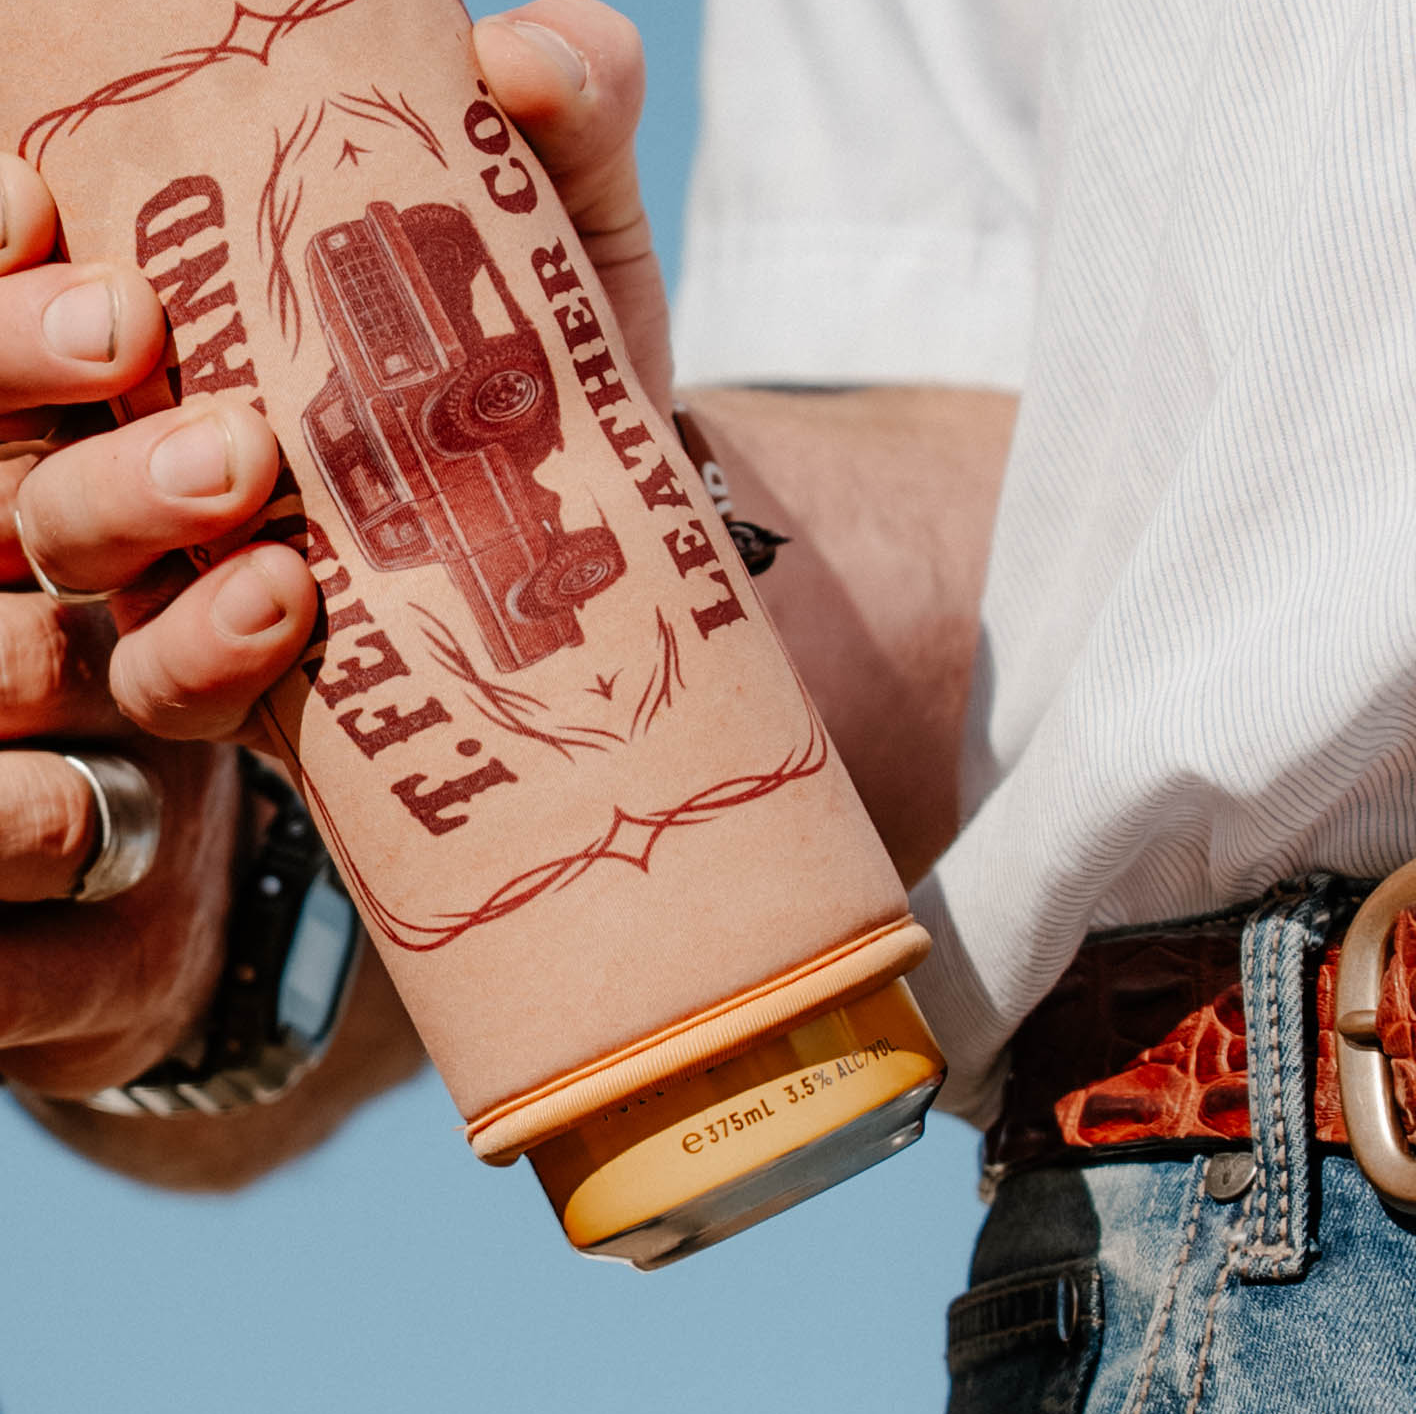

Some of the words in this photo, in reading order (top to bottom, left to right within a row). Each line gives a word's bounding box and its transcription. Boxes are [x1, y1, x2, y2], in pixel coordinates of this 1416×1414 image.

[464, 78, 537, 214] CO.
[530, 236, 749, 640] LEATHER
[784, 1069, 832, 1104] 3.5%
